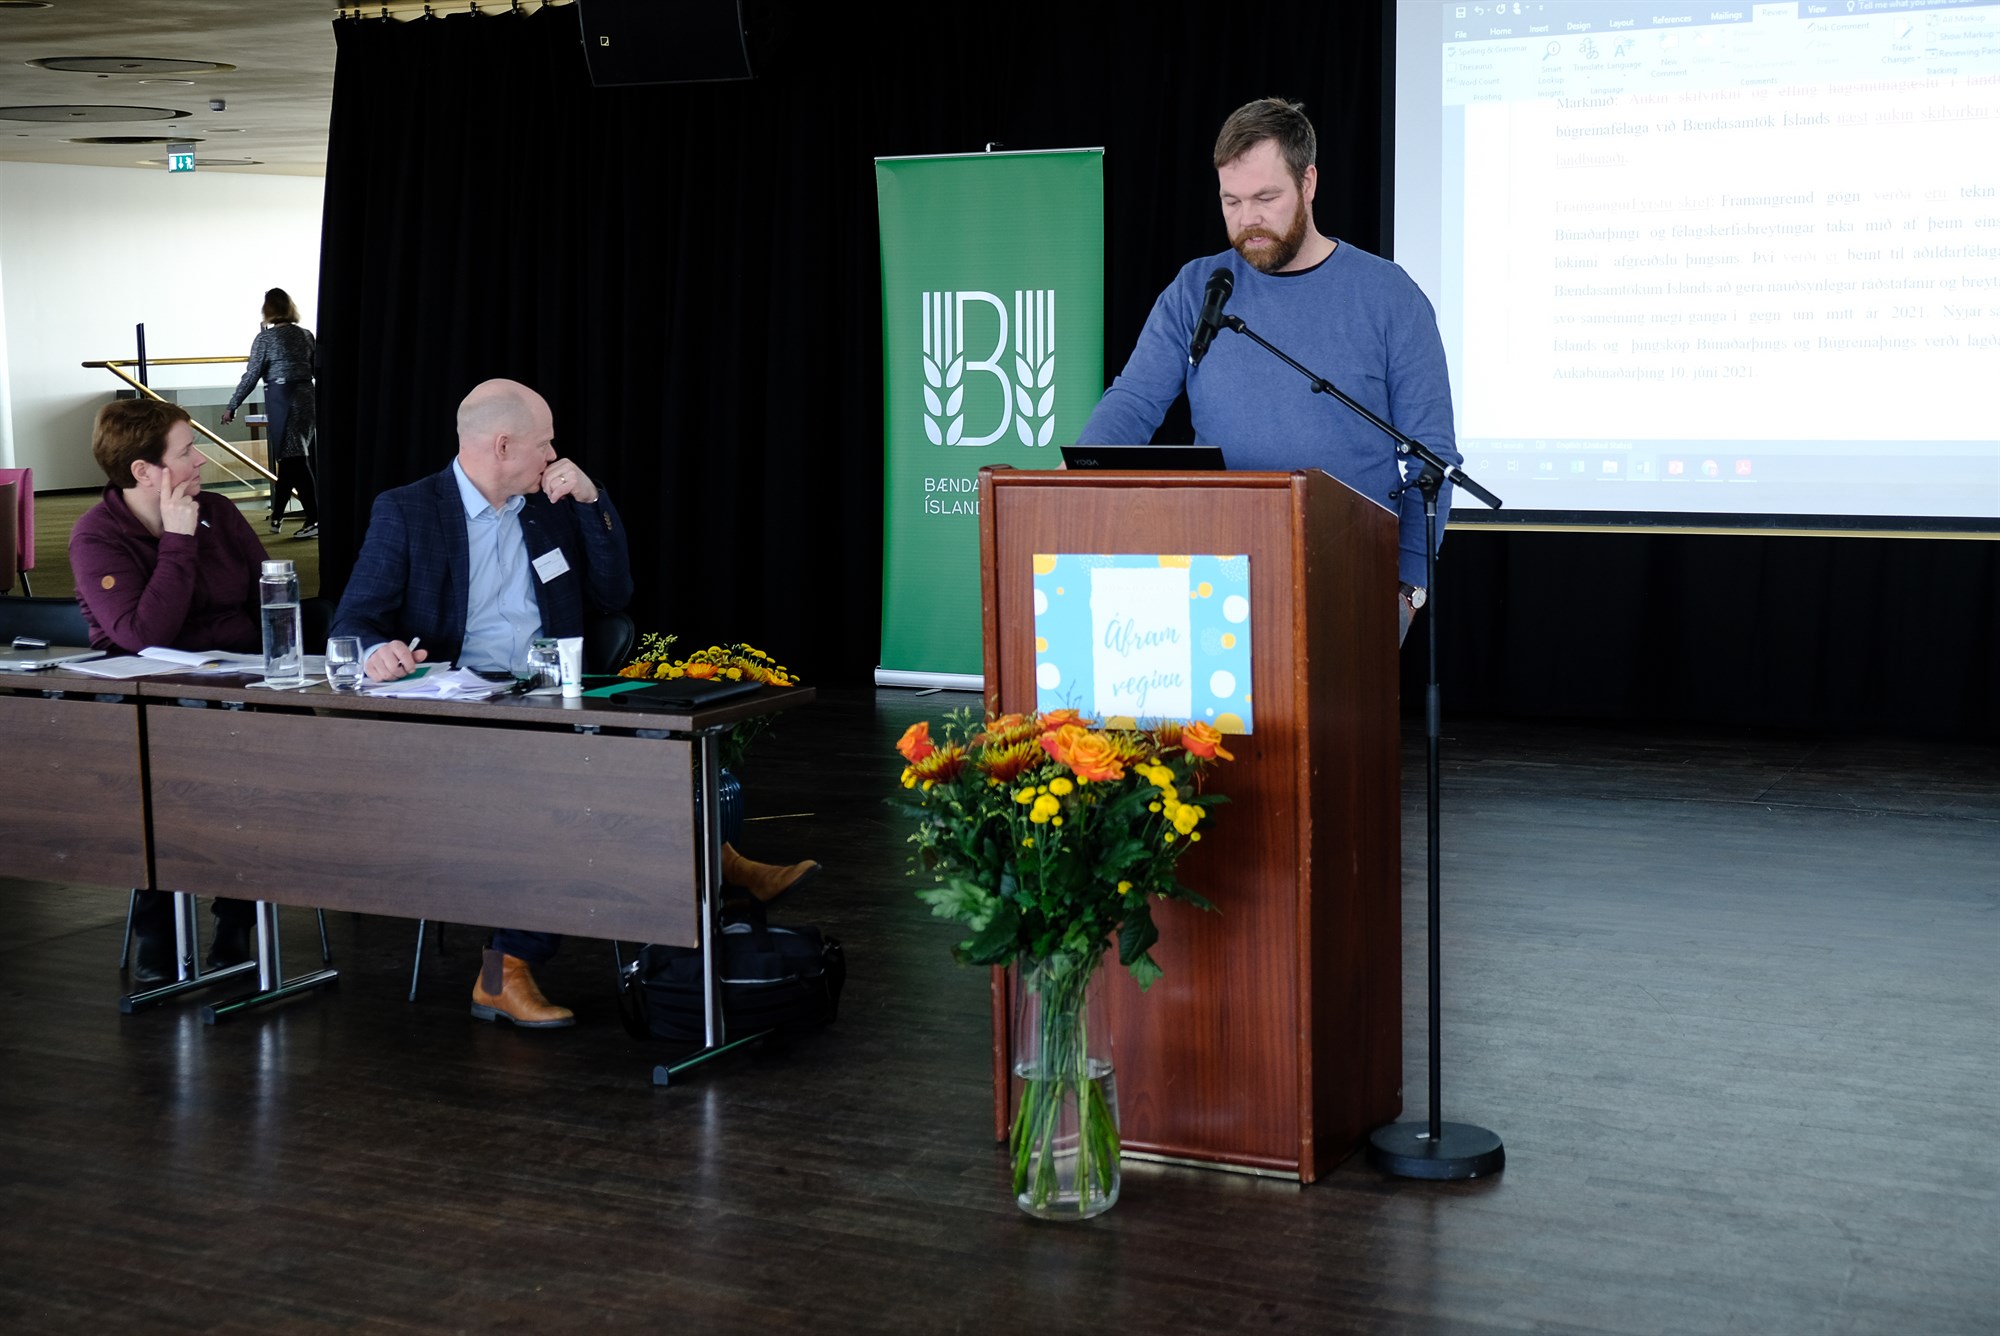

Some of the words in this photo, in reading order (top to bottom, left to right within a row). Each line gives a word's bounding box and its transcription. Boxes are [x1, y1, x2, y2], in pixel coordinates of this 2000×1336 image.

[1762, 8, 1788, 17] Review
[1807, 5, 1828, 15] View
[1652, 14, 1692, 25] References
[1710, 10, 1743, 22] Mailings
[1955, 14, 1986, 23] Markup
[1567, 22, 1591, 33] Design
[1609, 18, 1635, 29] Layout
[1831, 22, 1870, 31] Comment
[1490, 27, 1512, 36] Home
[1529, 24, 1549, 34] Insert
[1455, 31, 1468, 40] File
[1963, 30, 1994, 40] Markup
[1459, 47, 1485, 57] Spelling
[1494, 44, 1527, 53] Grammar
[1892, 43, 1912, 52] Track
[1939, 48, 1979, 58] Reviewing
[1661, 58, 1677, 66] New
[1882, 55, 1916, 65] Changes
[1459, 62, 1493, 71] Thesaurus
[1541, 65, 1562, 73] Smart
[1574, 62, 1604, 72] Translate
[1607, 60, 1642, 72] Language
[1926, 66, 1958, 76] Tracking
[1651, 69, 1688, 78] Comment
[1459, 78, 1480, 87] Word
[1481, 77, 1500, 86] Count
[1538, 76, 1564, 86] Lookup
[1740, 77, 1778, 86] Comments
[1538, 89, 1565, 98] Insights
[1590, 86, 1624, 96] Language
[1473, 93, 1502, 102] Proofing
[1629, 94, 1669, 106] Aukin
[1752, 88, 1768, 101] og
[1556, 122, 1649, 140] búgreinafélaga
[1656, 120, 1676, 133] við
[1683, 114, 1776, 132] Bændasamtök
[1783, 110, 1830, 127] Íslands
[1875, 108, 1914, 123] aukin
[1921, 103, 1988, 121] skilvirkni
[1722, 192, 1814, 209] Framangreind
[1826, 190, 1860, 206] gögn
[1960, 184, 1996, 199] tekin
[1555, 227, 1640, 243] Búnaðarþingi
[1650, 228, 1666, 241] og
[1672, 221, 1815, 240] félagskerfisbreytingar
[1826, 219, 1854, 233] taka
[1866, 218, 1892, 232] mið
[1904, 216, 1919, 230] af
[1928, 216, 1963, 232] þeim
[1554, 256, 1598, 269] lokinni
[1614, 254, 1678, 270] afgreiðslu
[1752, 250, 1775, 264] Því
[1848, 248, 1881, 261] beint
[1891, 246, 1904, 260] til
[1554, 283, 1663, 298] Bændasamtökum
[1667, 279, 1713, 295] Íslands
[1716, 280, 1732, 294] að
[1735, 283, 1763, 297] gera
[1768, 278, 1857, 295] nauðsynlegar
[1862, 274, 1936, 291] ráðstafanir
[1940, 278, 1958, 292] og
[1553, 312, 1575, 325] svo
[1580, 311, 1645, 327] sameining
[1651, 312, 1683, 326] megi
[1688, 311, 1727, 326] ganga
[1749, 310, 1781, 325] gegn
[1793, 309, 1814, 321] um
[1826, 307, 1854, 320] mitt
[1866, 305, 1880, 319] ár
[1943, 304, 1983, 321] Nýjar
[1553, 337, 1598, 352] Íslands
[1603, 340, 1619, 354] og
[1631, 337, 1690, 354] þingsköp
[1696, 336, 1788, 353] Búnaðarþings
[1793, 339, 1811, 352] og
[1818, 335, 1918, 351] Búgreinaþings
[1924, 334, 1959, 347] verði
[1553, 365, 1665, 382] Aukabúnaðarþing
[1074, 459, 1099, 467] YOGA
[1104, 612, 1181, 658] Áfram
[1113, 669, 1184, 709] veginn
